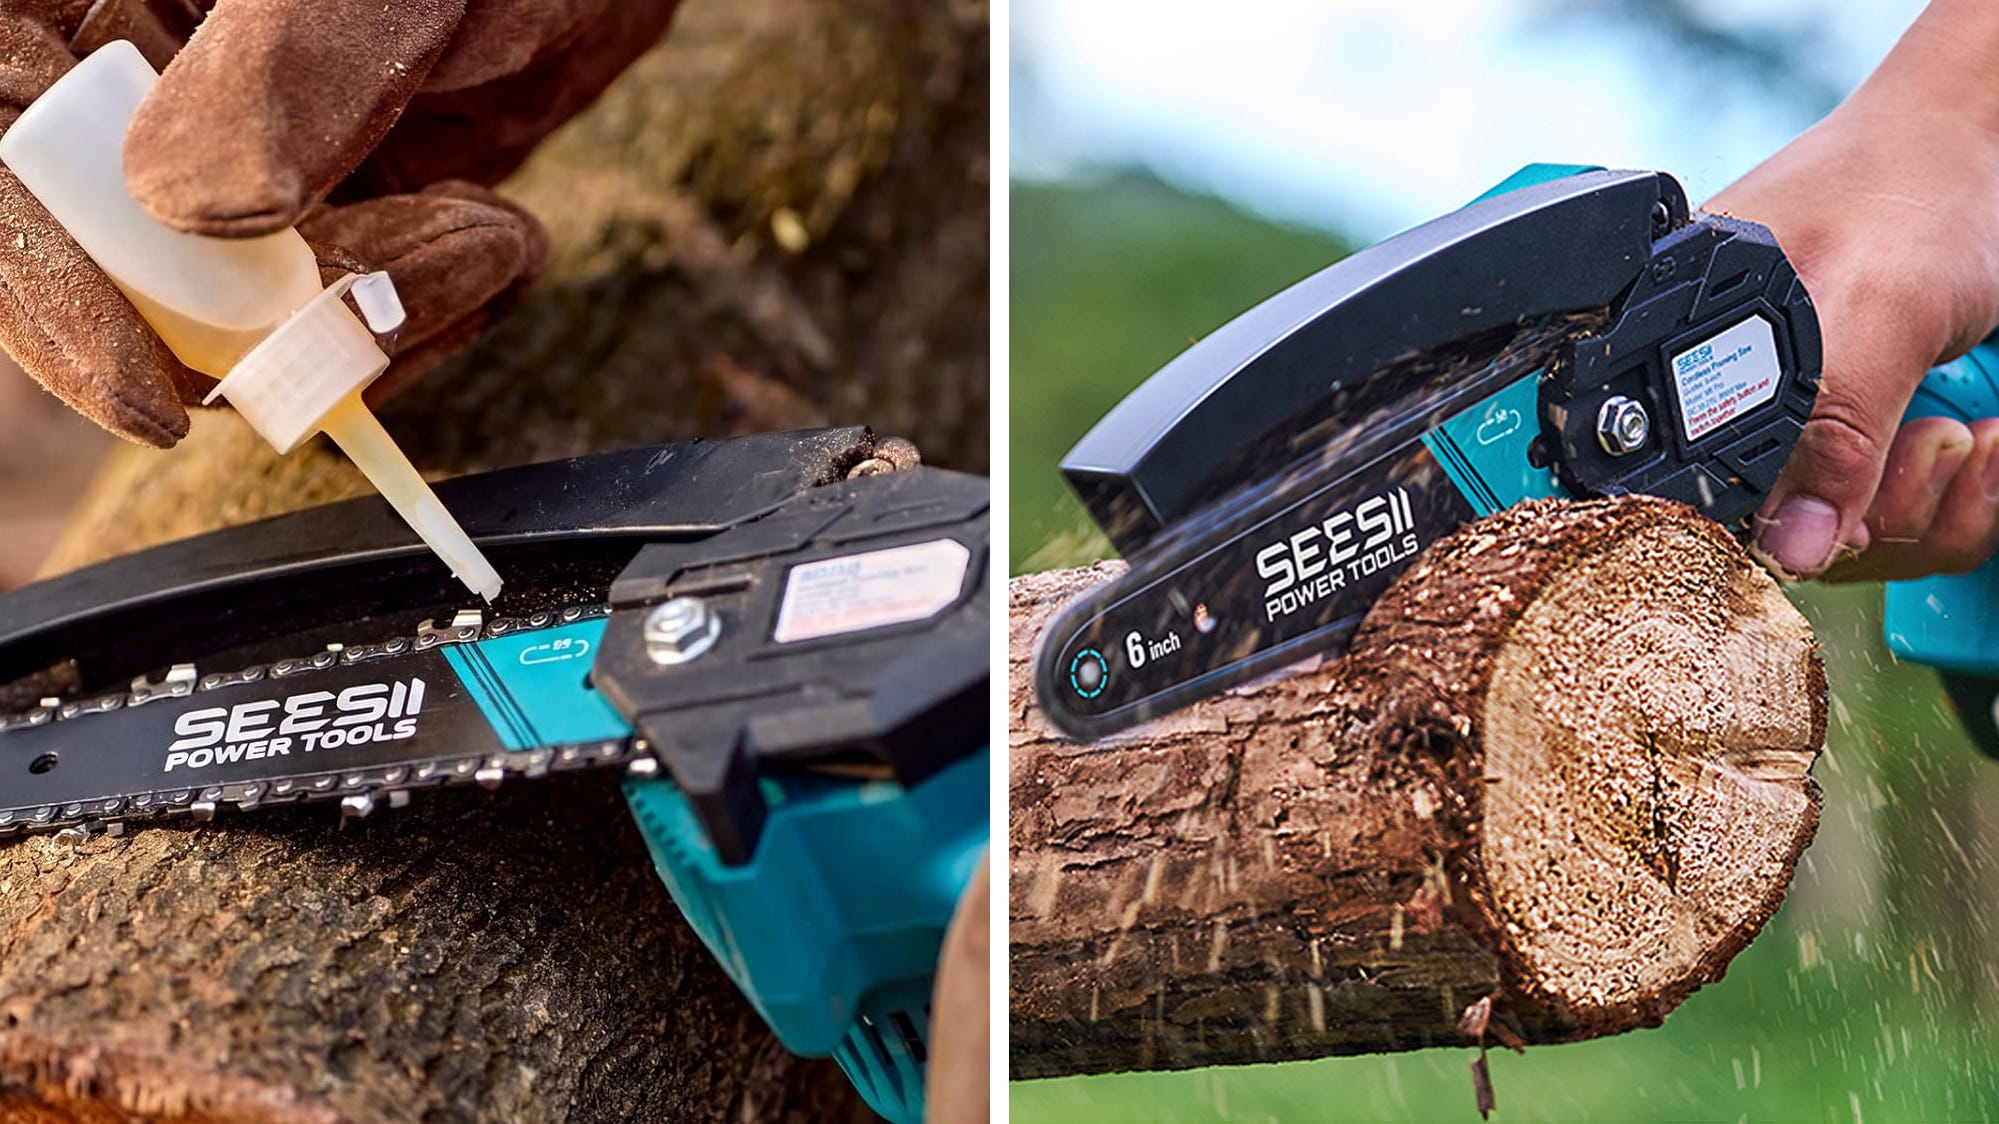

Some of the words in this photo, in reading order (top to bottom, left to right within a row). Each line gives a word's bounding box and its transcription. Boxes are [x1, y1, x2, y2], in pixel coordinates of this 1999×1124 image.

[1256, 486, 1415, 598] SEESII
[1265, 568, 1346, 622] POWER
[1347, 533, 1419, 581] TOOLS
[1125, 630, 1146, 669] 6
[1148, 631, 1181, 661] inch
[164, 738, 293, 772] POWER
[301, 718, 418, 752] TOOLS
[168, 677, 426, 751] SEESII
